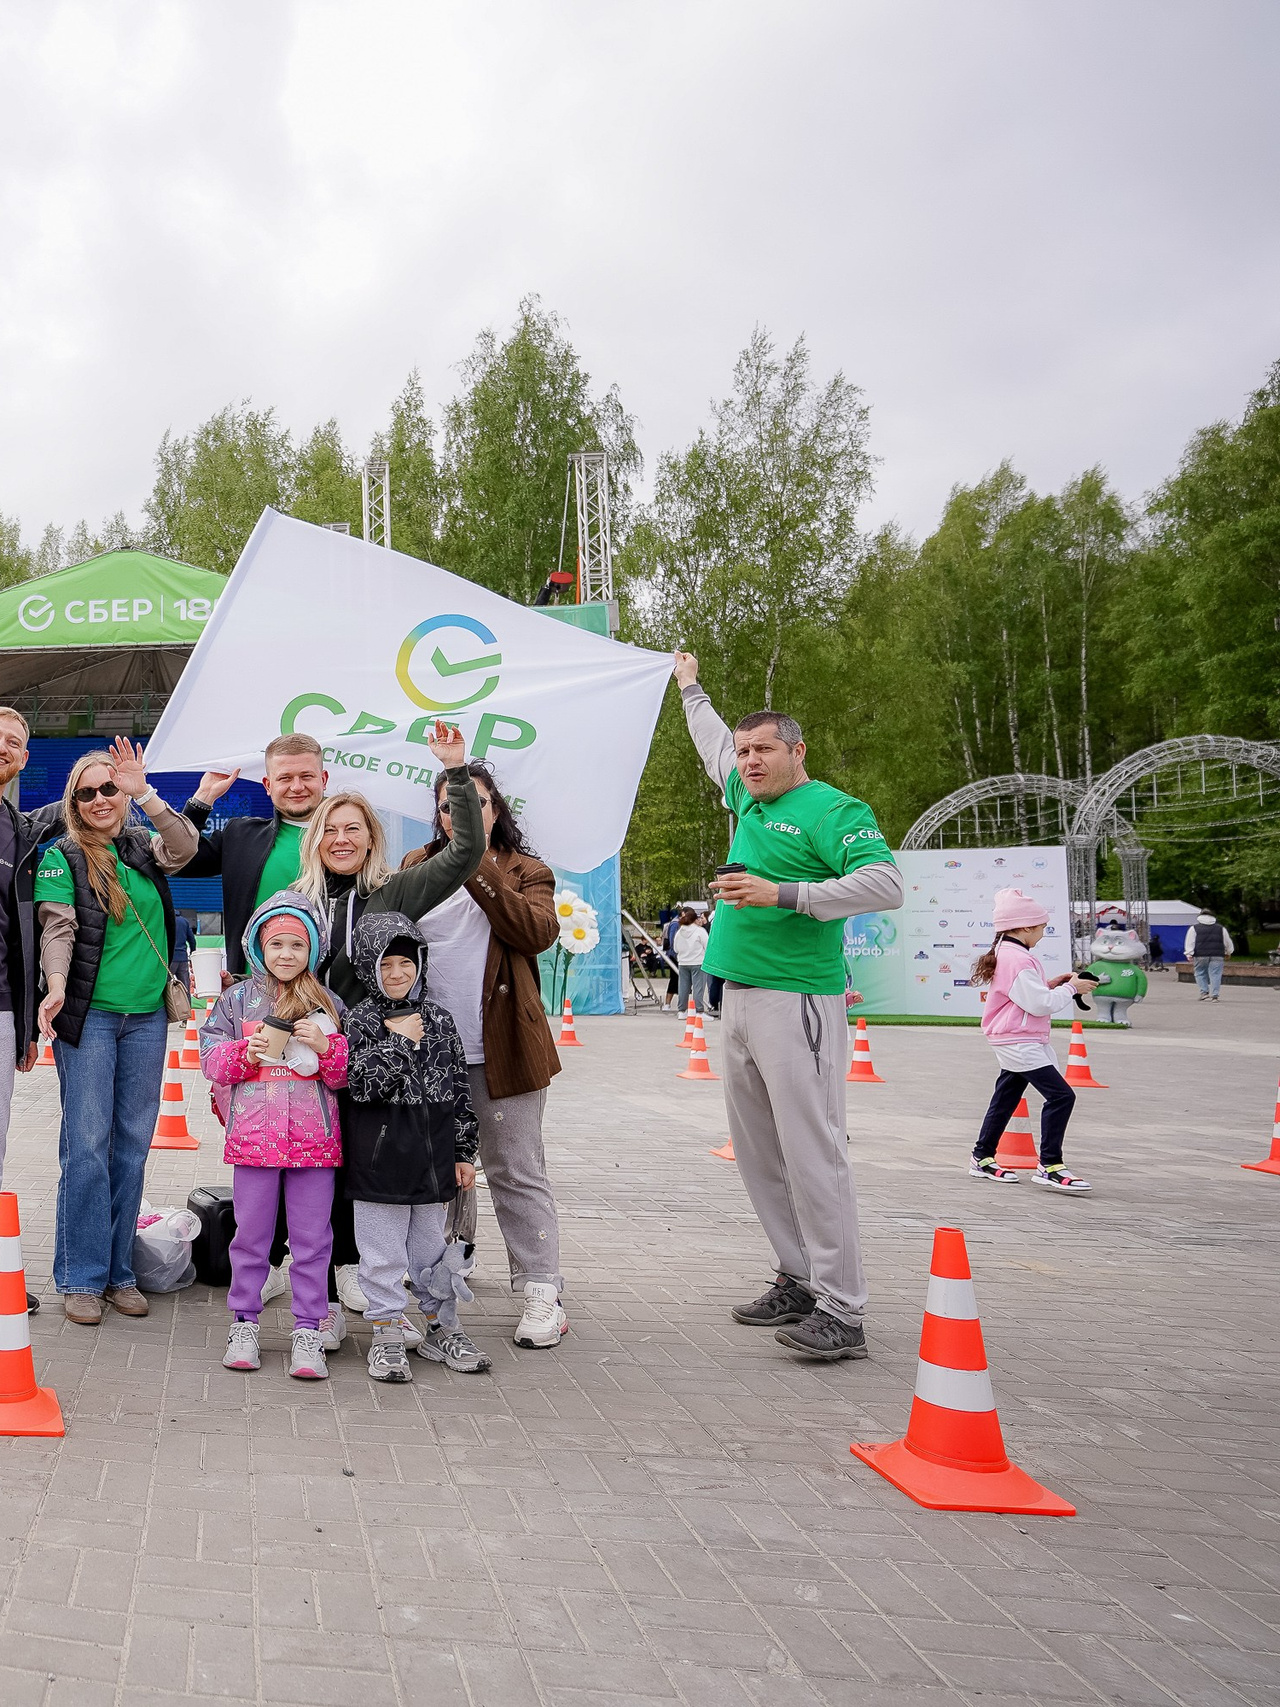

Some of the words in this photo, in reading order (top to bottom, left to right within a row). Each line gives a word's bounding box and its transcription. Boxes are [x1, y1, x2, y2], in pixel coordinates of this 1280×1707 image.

[64, 599, 153, 624] СБЕР
[773, 822, 801, 836] СБЕР
[37, 868, 64, 878] СБЕР
[844, 944, 901, 958] арафон
